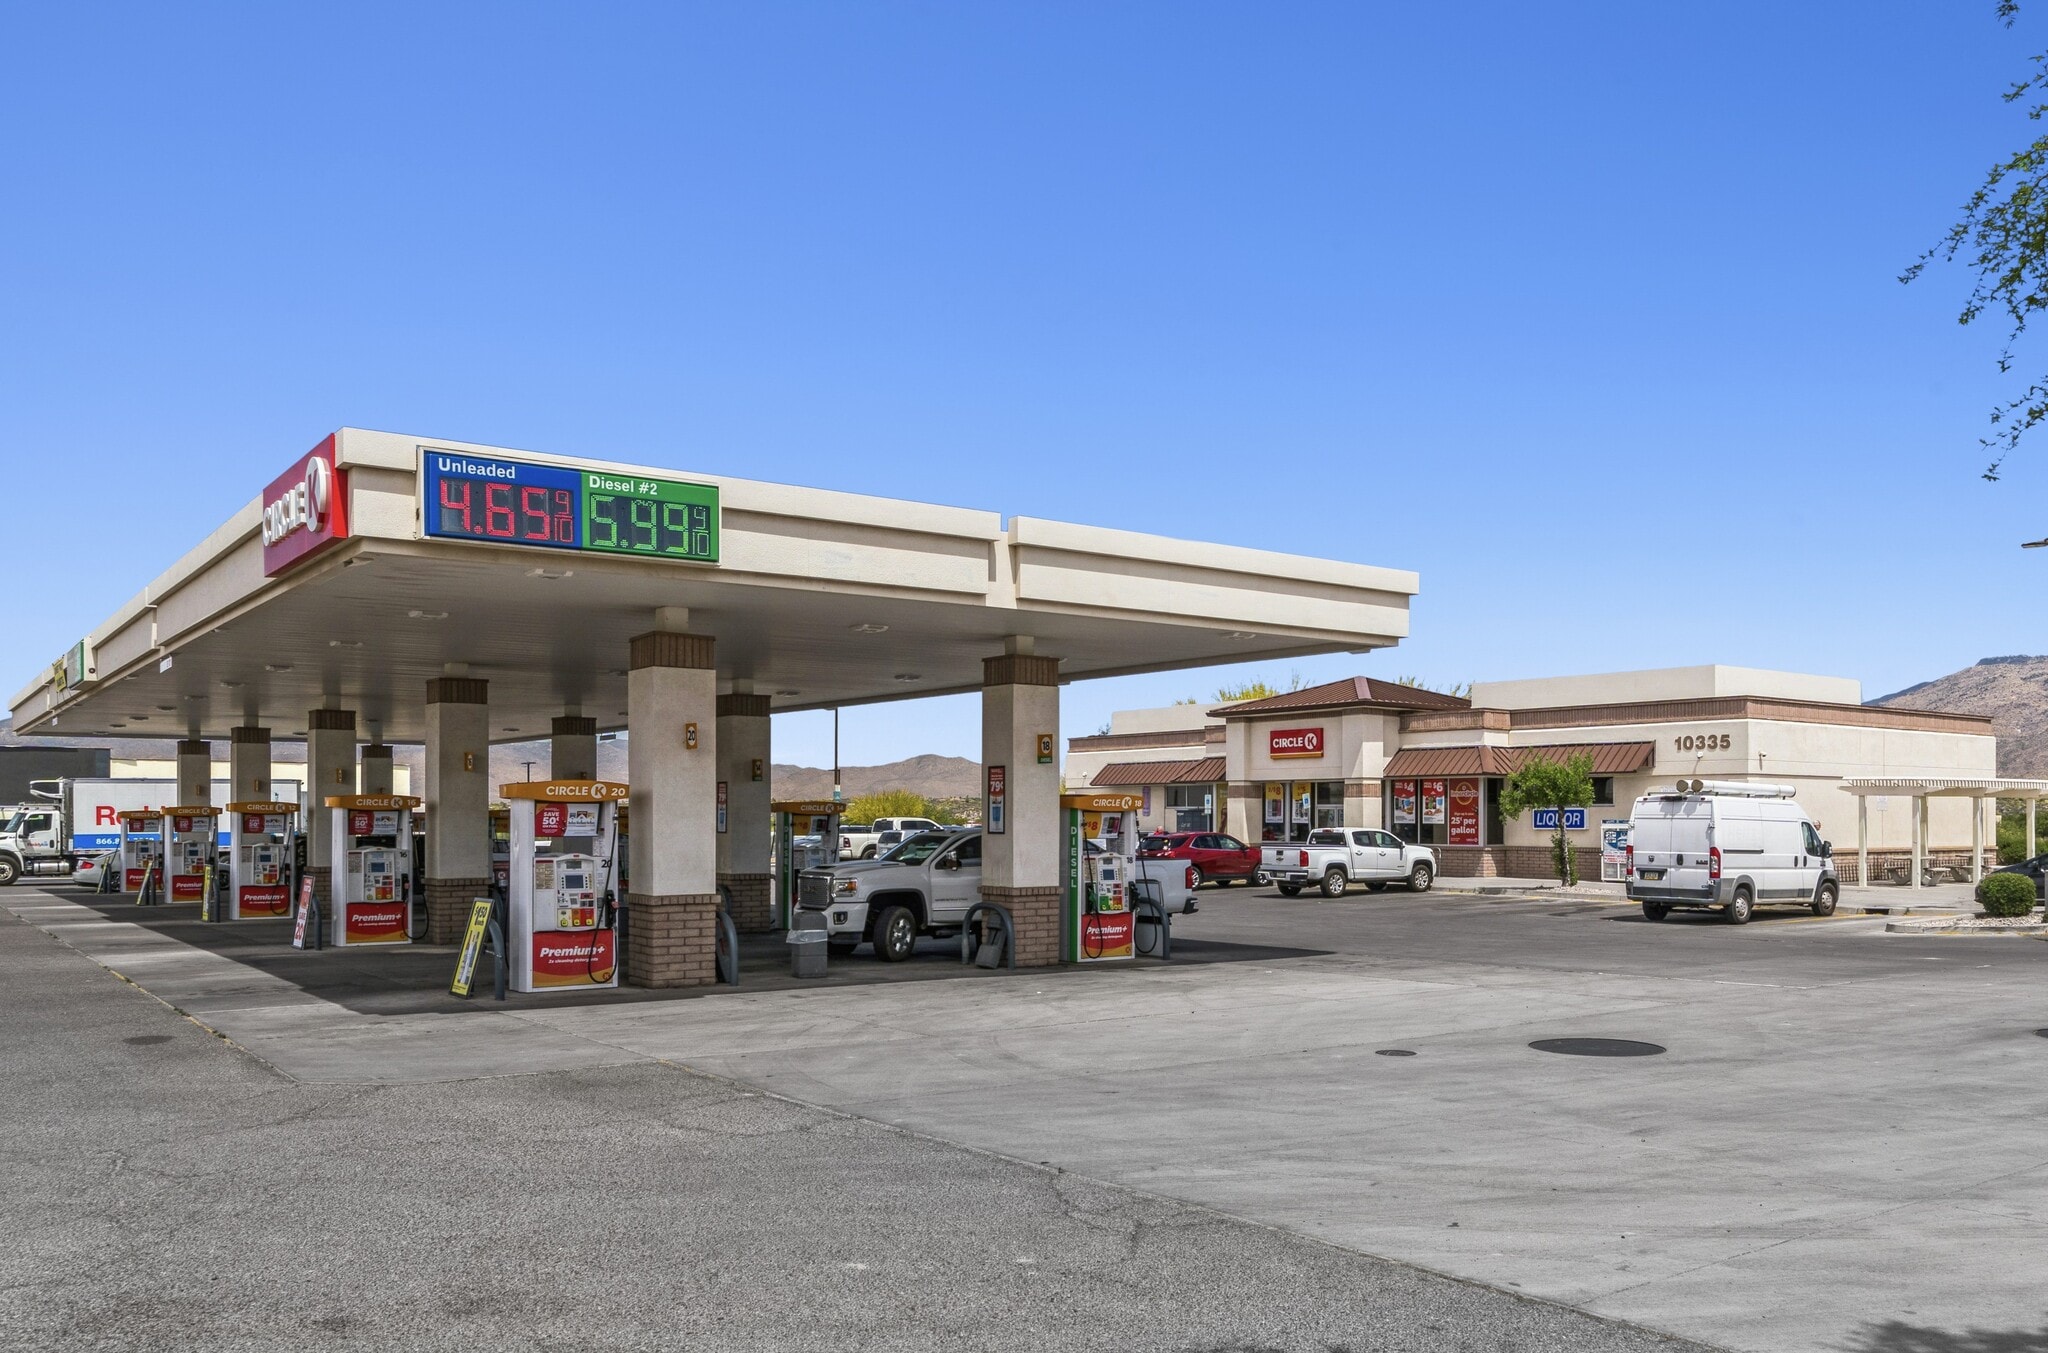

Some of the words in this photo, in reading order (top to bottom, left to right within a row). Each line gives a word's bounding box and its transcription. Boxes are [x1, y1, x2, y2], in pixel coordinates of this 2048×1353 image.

[438, 457, 516, 479] Unleaded
[589, 475, 634, 493] Diesel
[638, 481, 658, 495] #2
[262, 482, 306, 546] CIRCLE
[305, 456, 326, 532] K
[440, 479, 550, 541] 4.65
[590, 494, 689, 554] 5.99
[688, 730, 696, 742] 20
[1272, 737, 1304, 749] CIRCLE
[1304, 733, 1318, 750] K
[1042, 740, 1051, 751] 18
[1674, 734, 1731, 751] 10335
[546, 785, 589, 796] CIRCLE
[590, 783, 607, 799] K
[611, 787, 626, 797] 20
[1403, 782, 1414, 792] $4
[1433, 782, 1443, 792] $6
[274, 803, 286, 813] K
[356, 798, 389, 807] CIRCLE
[390, 797, 403, 809] K
[825, 803, 834, 813] K
[1093, 798, 1121, 807] CIRCLE
[1121, 796, 1133, 810] K
[1463, 818, 1476, 826] per
[1070, 826, 1079, 888] DIESEL
[1126, 856, 1134, 864] 18
[352, 913, 402, 922] Premium+
[1086, 924, 1128, 934] Premium+
[540, 945, 606, 958] Premium+
